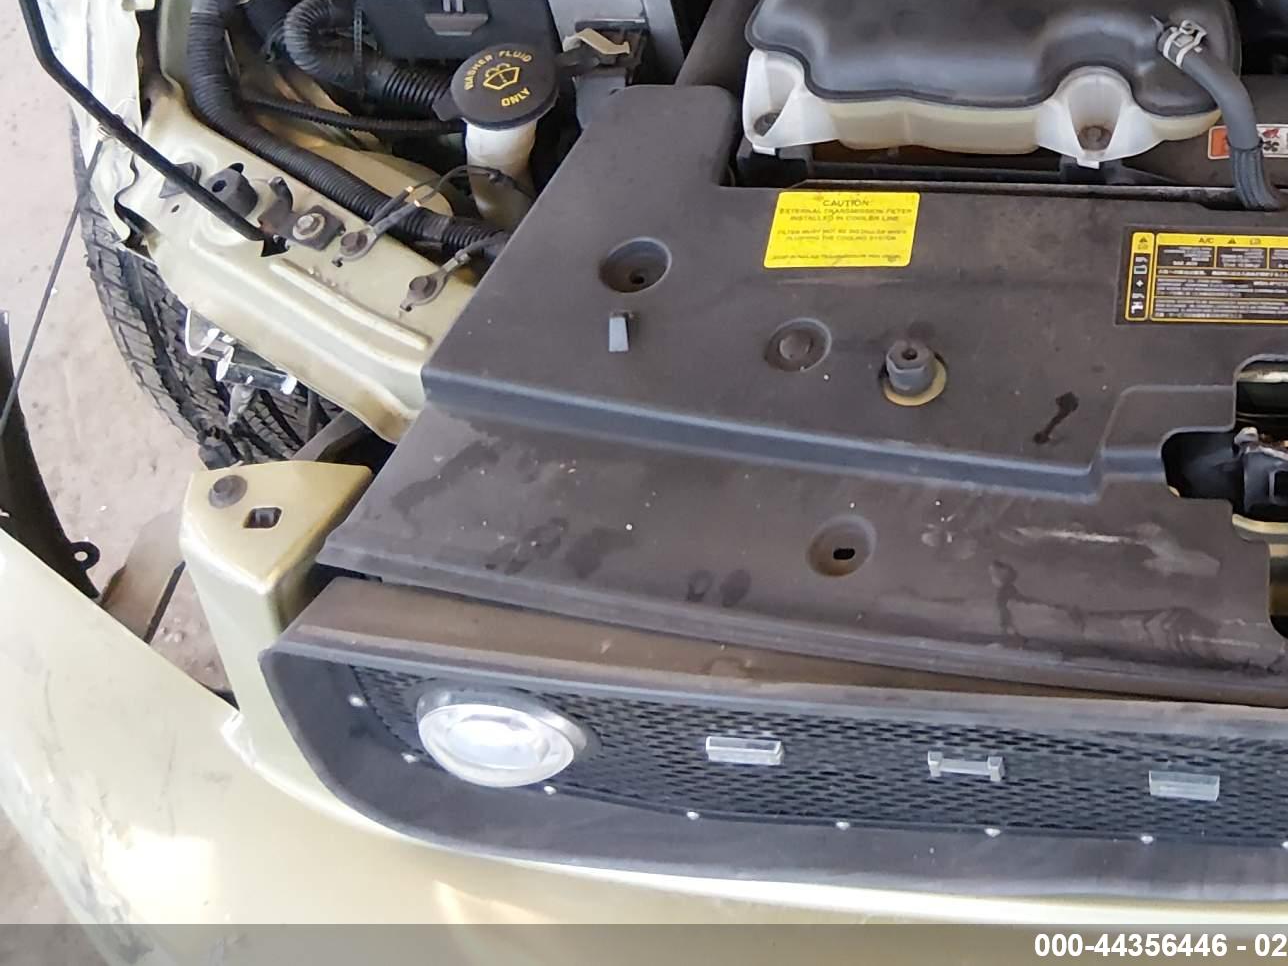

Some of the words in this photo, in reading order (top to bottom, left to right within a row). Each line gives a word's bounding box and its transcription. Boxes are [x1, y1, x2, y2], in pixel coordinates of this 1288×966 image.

[463, 54, 494, 90] WASHER
[498, 50, 532, 62] FLUID
[501, 87, 531, 107] ONLY
[823, 198, 869, 207] CAUTION
